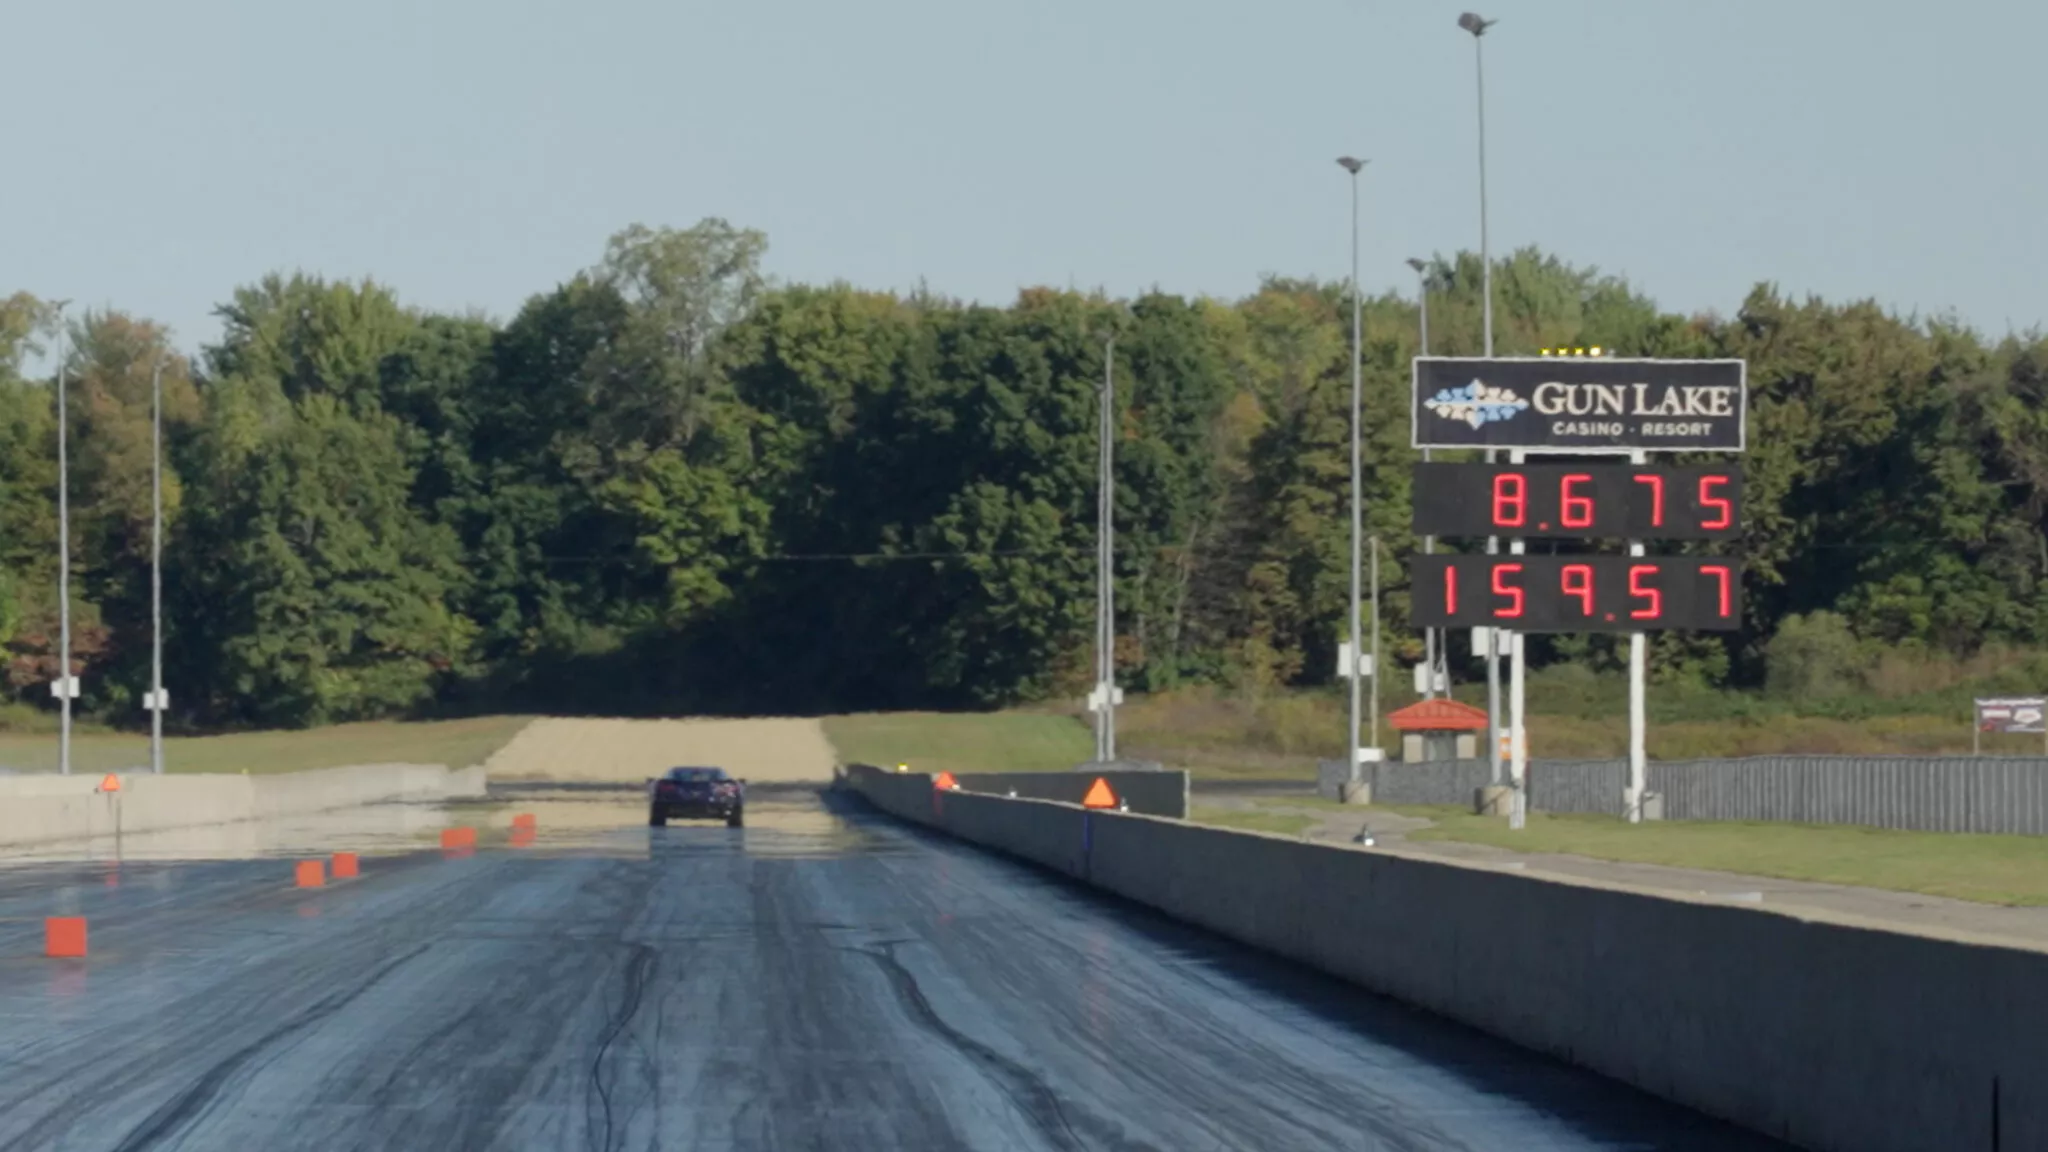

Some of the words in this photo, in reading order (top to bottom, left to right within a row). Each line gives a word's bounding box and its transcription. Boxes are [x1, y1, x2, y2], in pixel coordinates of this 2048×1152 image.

[1532, 381, 1627, 416] GUN
[1632, 383, 1734, 417] LAKE
[1552, 421, 1623, 436] CASINO
[1641, 422, 1713, 437] RESORT
[1492, 473, 1733, 529] 8.675
[1444, 563, 1732, 620] 159.57
